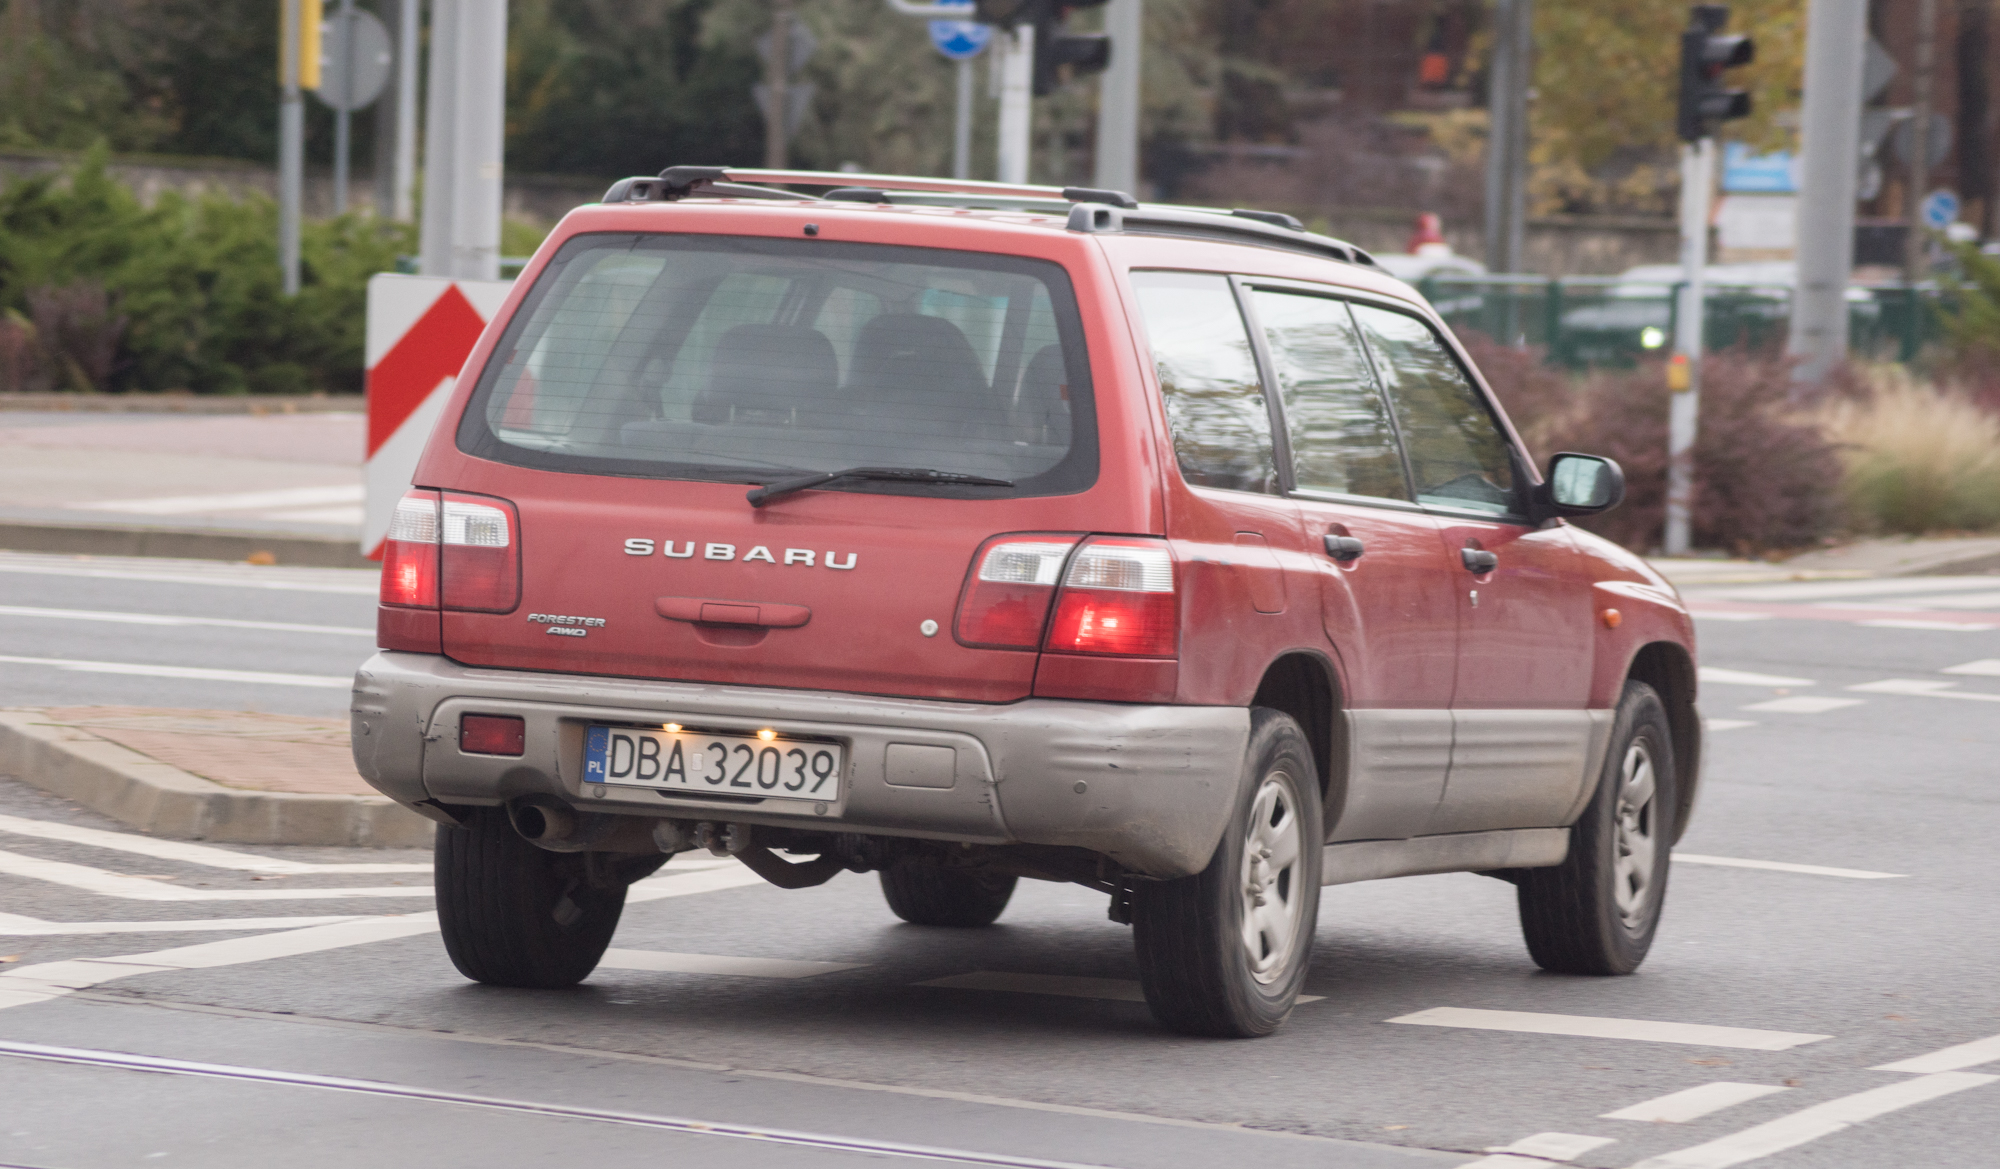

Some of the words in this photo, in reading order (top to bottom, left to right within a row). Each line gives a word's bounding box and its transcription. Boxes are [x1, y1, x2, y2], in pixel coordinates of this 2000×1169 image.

[624, 538, 858, 570] SUBARU
[527, 613, 606, 628] FORESTER
[546, 626, 587, 637] AWD
[588, 760, 604, 774] PL
[609, 734, 687, 783] DBA
[704, 742, 834, 793] 32039
